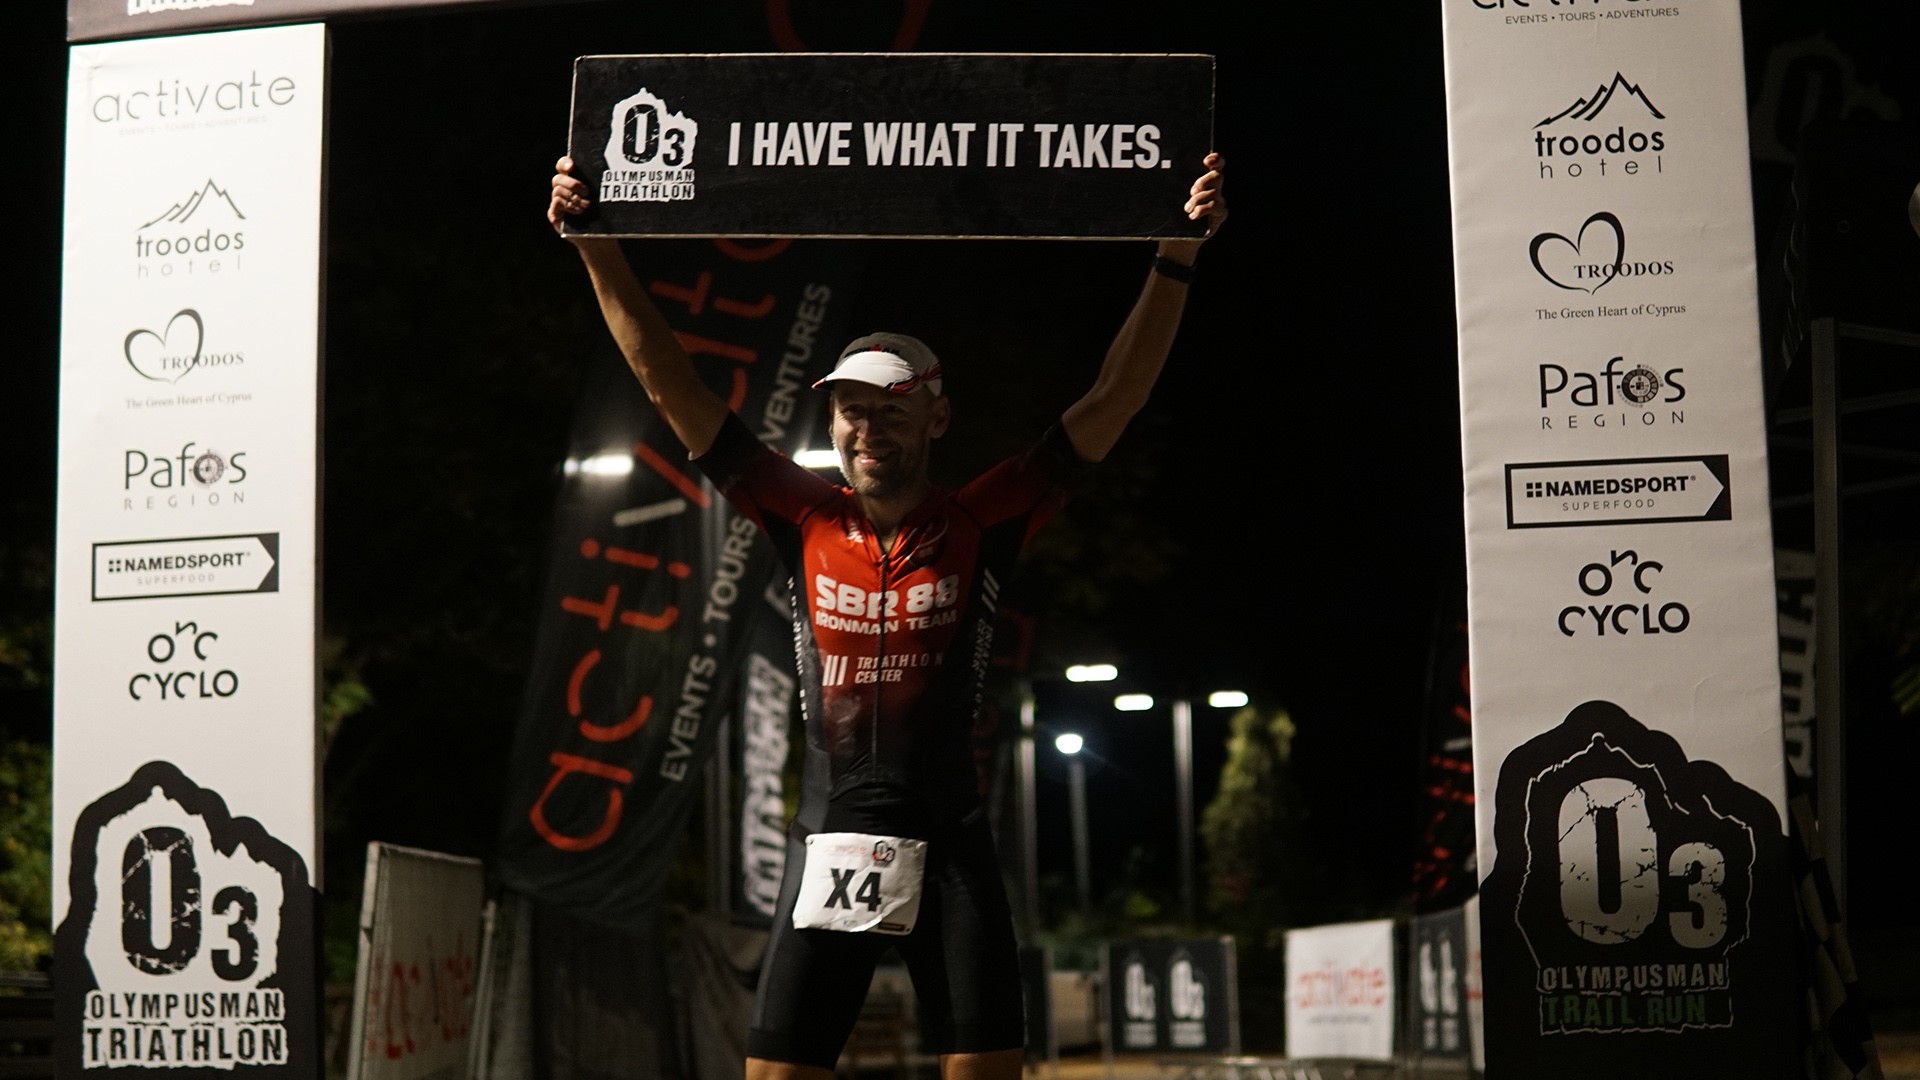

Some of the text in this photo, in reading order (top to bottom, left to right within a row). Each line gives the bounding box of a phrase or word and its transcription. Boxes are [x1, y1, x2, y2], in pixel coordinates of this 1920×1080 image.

[1505, 8, 1680, 25] EVENTS TOURS ADVENTURES
[92, 70, 296, 123] activate
[727, 122, 1172, 169] I HAVE WHAT IT TAKES.
[1535, 126, 1665, 157] troodos
[604, 170, 693, 182] OLYMPUSMAN
[1540, 155, 1662, 179] hotel
[602, 185, 692, 199] TRIATHLON
[136, 228, 244, 258] troodos
[1573, 260, 1675, 280] TROODOS
[1536, 303, 1687, 320] The Green Heart of Cyprus
[159, 351, 245, 371] TROODOS
[1539, 356, 1687, 409] Pafos
[126, 391, 252, 410] The Green Heart of Cyprus
[1541, 410, 1685, 430] REGION
[124, 441, 247, 490] Pafos
[124, 491, 245, 511] REGION
[1562, 498, 1656, 512] SUPERFOOD
[660, 281, 832, 783] EVENTS TOURS VENTURES
[137, 572, 216, 586] SUPERFOOD
[815, 573, 960, 620] SBR 88
[815, 609, 957, 636] IRONMAN TEAM
[1558, 601, 1691, 637] CYCLO
[857, 651, 945, 670] TRIATHLON
[128, 669, 239, 701] CYCLO
[854, 669, 903, 684] CENTER
[822, 867, 882, 912] X4
[1542, 962, 1726, 992] OLYMPUSMAN
[90, 991, 281, 1020] OLYMPUSMAN
[1544, 994, 1706, 1026] TRAIL RUN
[86, 1027, 283, 1062] TRIATHLON
